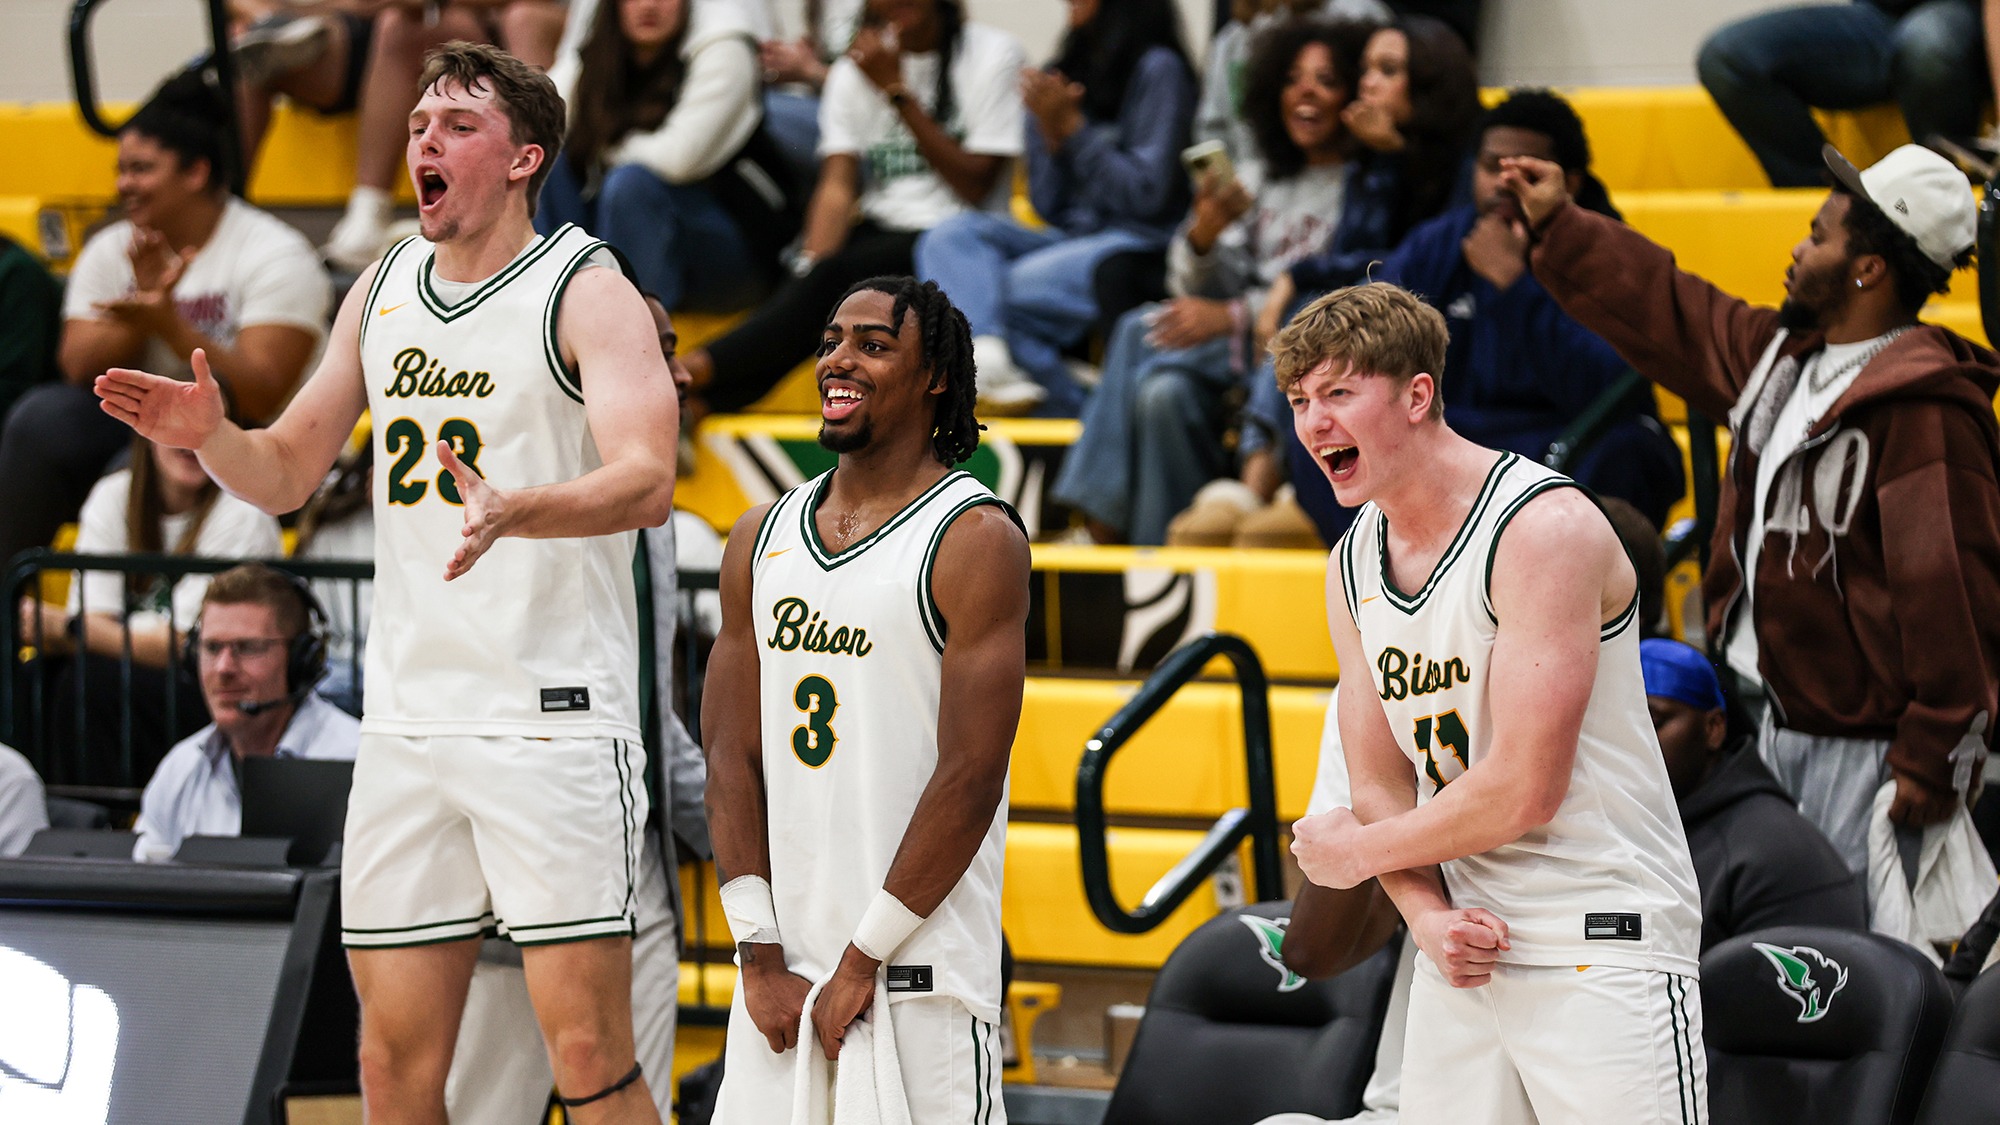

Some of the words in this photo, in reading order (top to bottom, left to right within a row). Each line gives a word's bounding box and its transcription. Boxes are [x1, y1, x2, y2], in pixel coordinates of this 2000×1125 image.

[384, 347, 495, 399] Bison
[767, 595, 873, 658] Bison
[1377, 646, 1470, 701] Bison
[790, 673, 842, 770] 3
[1412, 707, 1470, 798] 11
[1625, 920, 1633, 931] L
[917, 973, 924, 984] L
